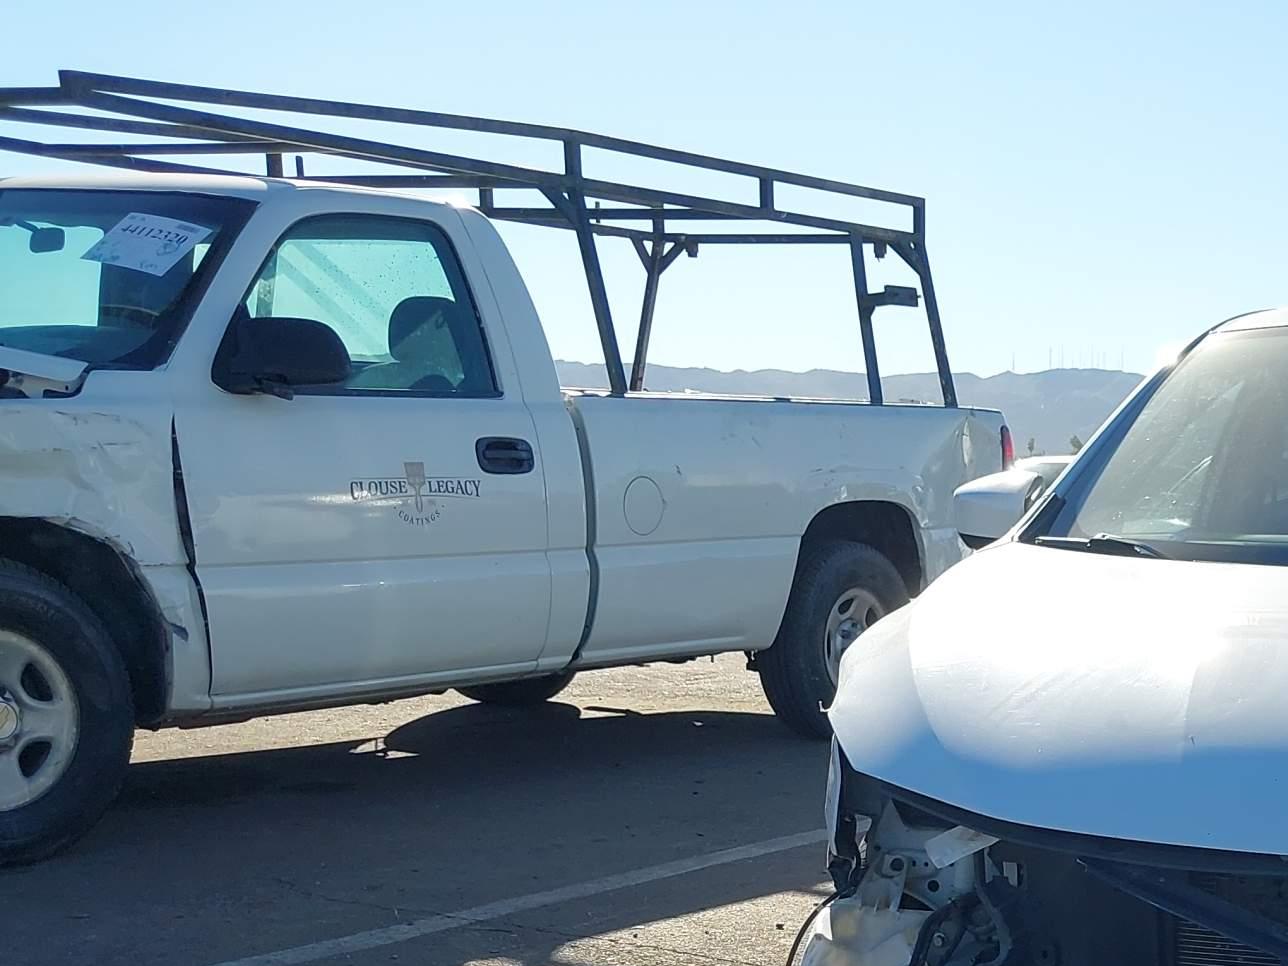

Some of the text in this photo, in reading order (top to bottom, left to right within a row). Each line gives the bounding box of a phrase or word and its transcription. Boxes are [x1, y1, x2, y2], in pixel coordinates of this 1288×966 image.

[121, 224, 189, 244] 44112320
[350, 480, 481, 500] CLOUSE LEGACY
[398, 509, 441, 526] COATINGS
